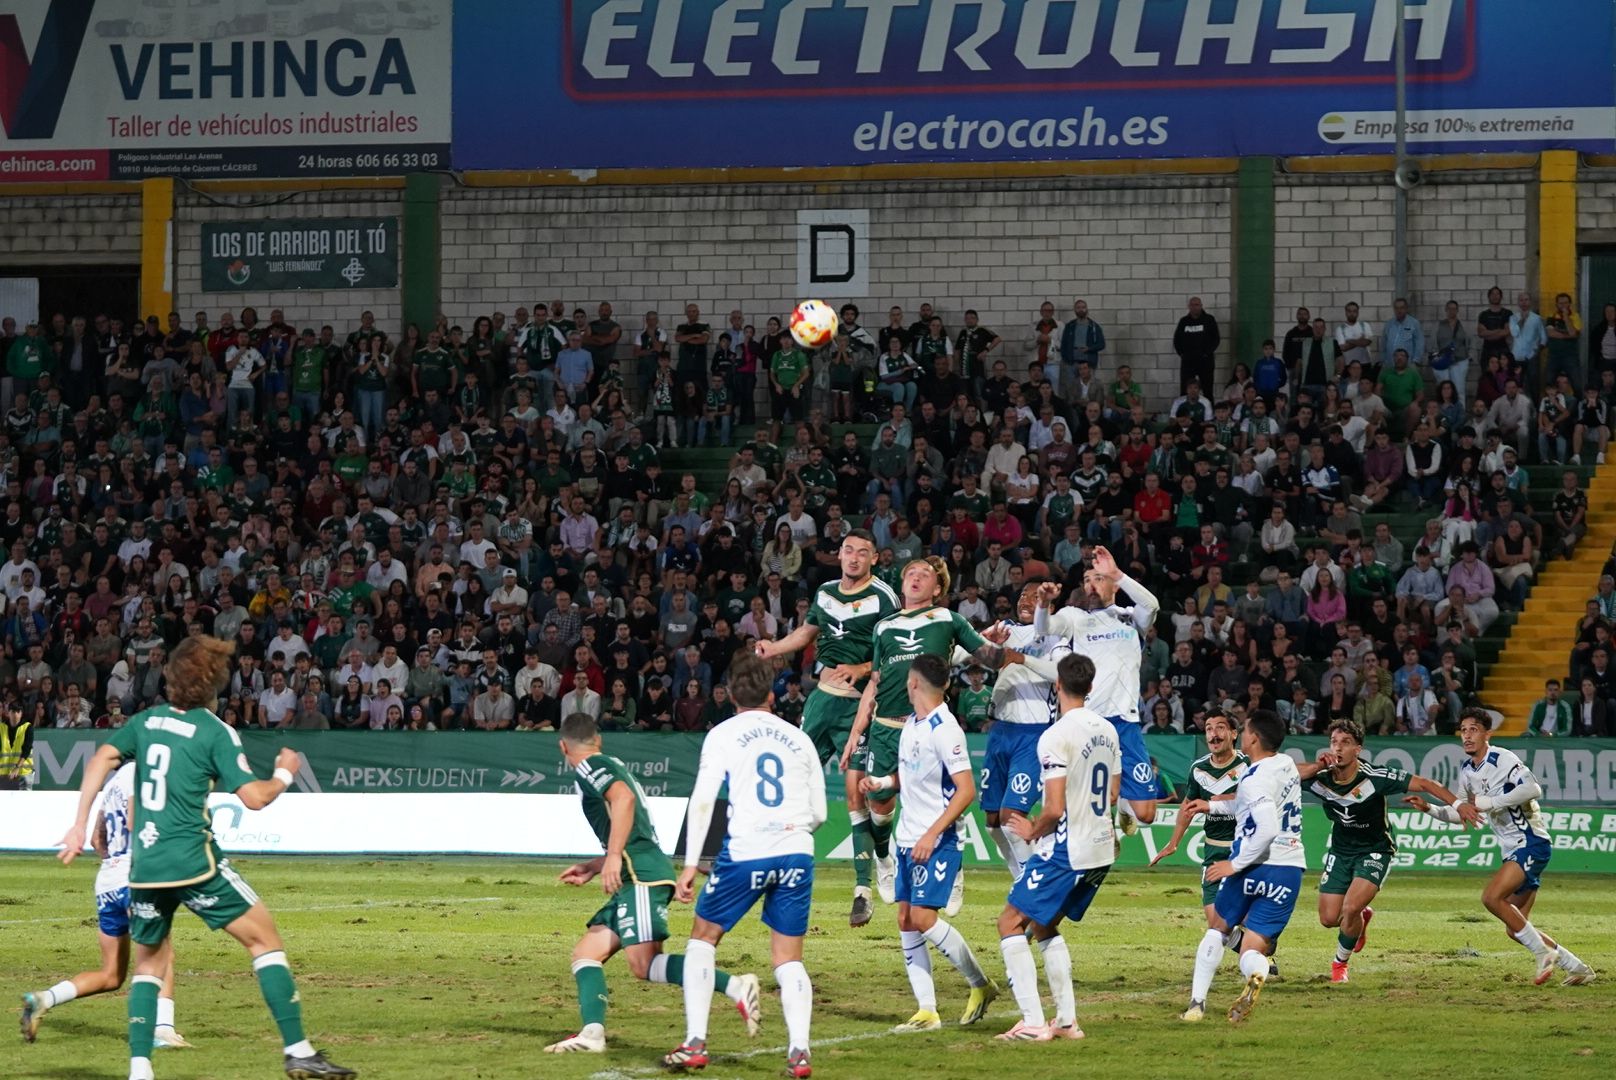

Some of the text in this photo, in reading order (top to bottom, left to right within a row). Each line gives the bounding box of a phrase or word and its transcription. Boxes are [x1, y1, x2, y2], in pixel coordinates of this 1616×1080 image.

[582, 0, 1455, 79] ELECTROCASH
[109, 37, 417, 100] VEHINCA
[107, 110, 418, 138] Taller de vehículos industriales
[853, 105, 1169, 152] electrocash.es
[1435, 118, 1476, 134] 100%
[1480, 115, 1574, 133] extremeña
[0, 156, 96, 172] ehinca.com
[221, 163, 258, 172] CÁCERES
[299, 152, 438, 168] 24 horas 606 66 33 03
[212, 223, 386, 257] LOS DE ARRIBA DEL TÓ
[810, 225, 855, 283] D
[1171, 675, 1196, 688] GAP
[737, 728, 763, 748] JAVI
[1081, 742, 1092, 760] DE
[141, 744, 171, 811] 3
[332, 766, 489, 788] APEXSTUDENT
[643, 757, 669, 776] gol
[756, 752, 785, 808] 8
[1090, 762, 1109, 816] 9
[1423, 853, 1460, 867] 42
[1467, 853, 1494, 867] 41
[750, 868, 805, 890] EAVE
[1242, 878, 1293, 905] EAVE
